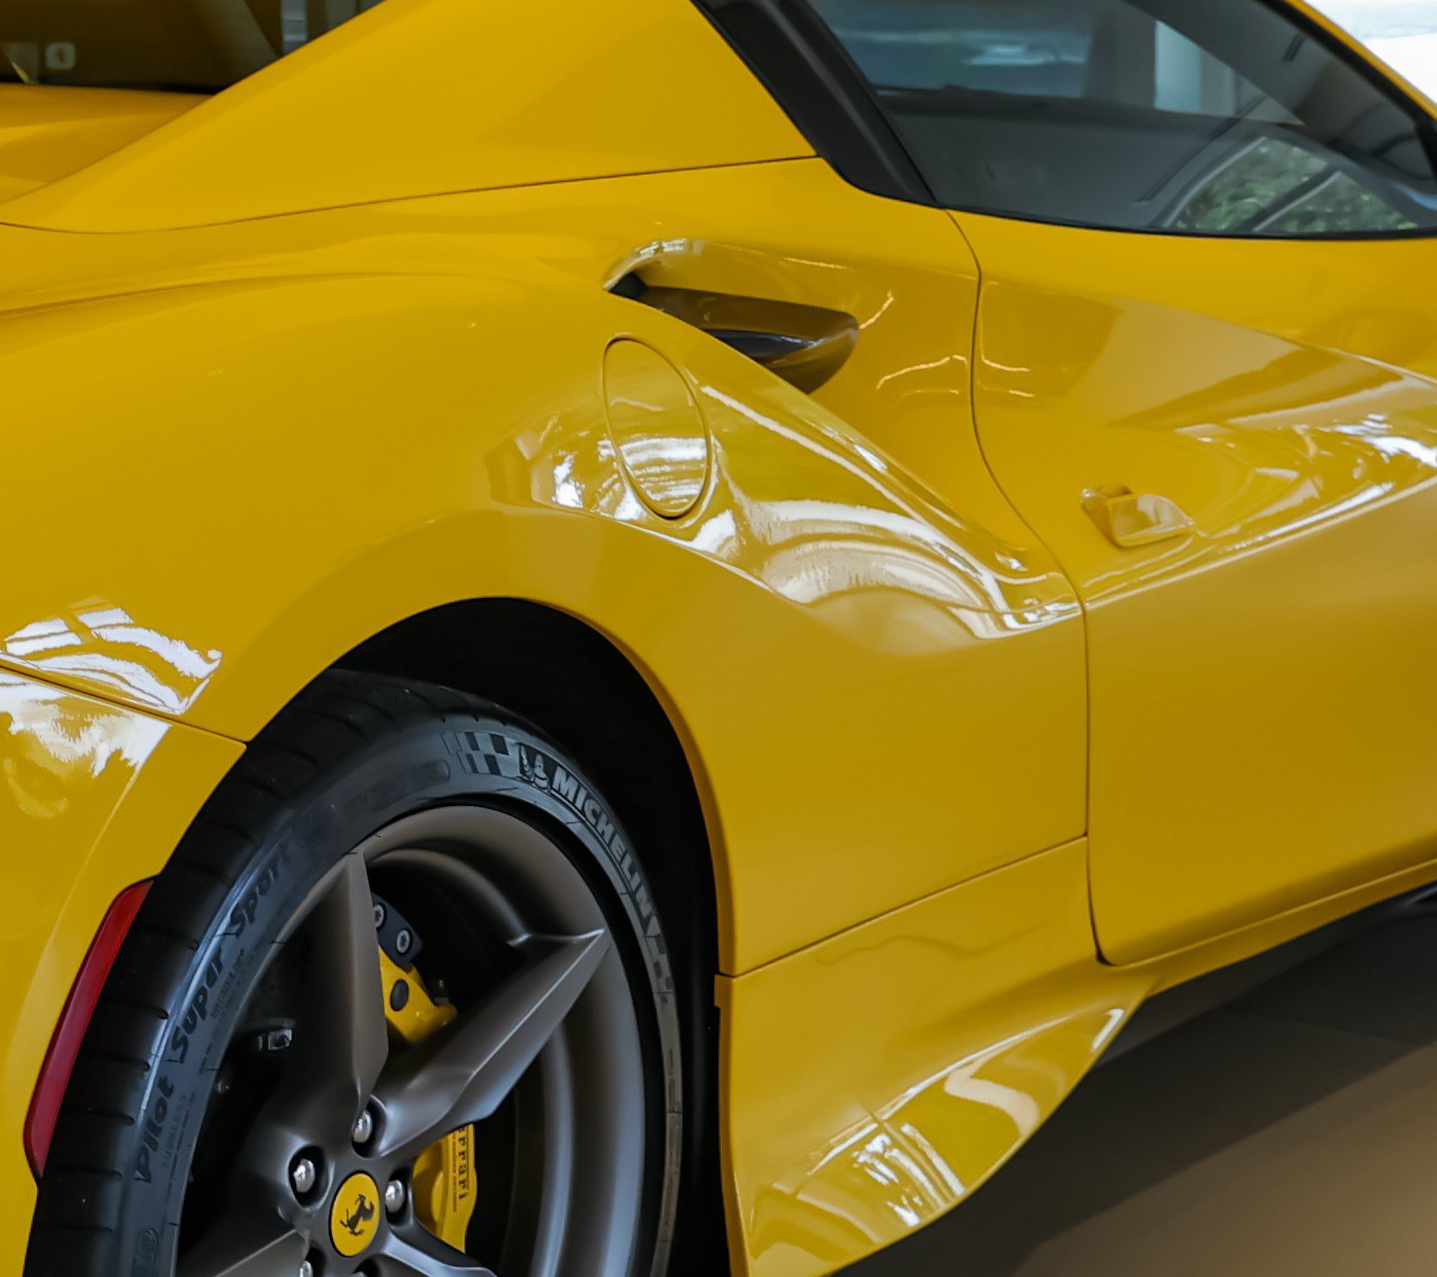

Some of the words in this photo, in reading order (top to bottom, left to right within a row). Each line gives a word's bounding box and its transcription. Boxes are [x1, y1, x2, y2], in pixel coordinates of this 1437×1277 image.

[551, 766, 653, 920] MICHELIN
[133, 1075, 175, 1184] Pilot
[167, 946, 225, 1064] Super
[219, 842, 292, 938] Sport
